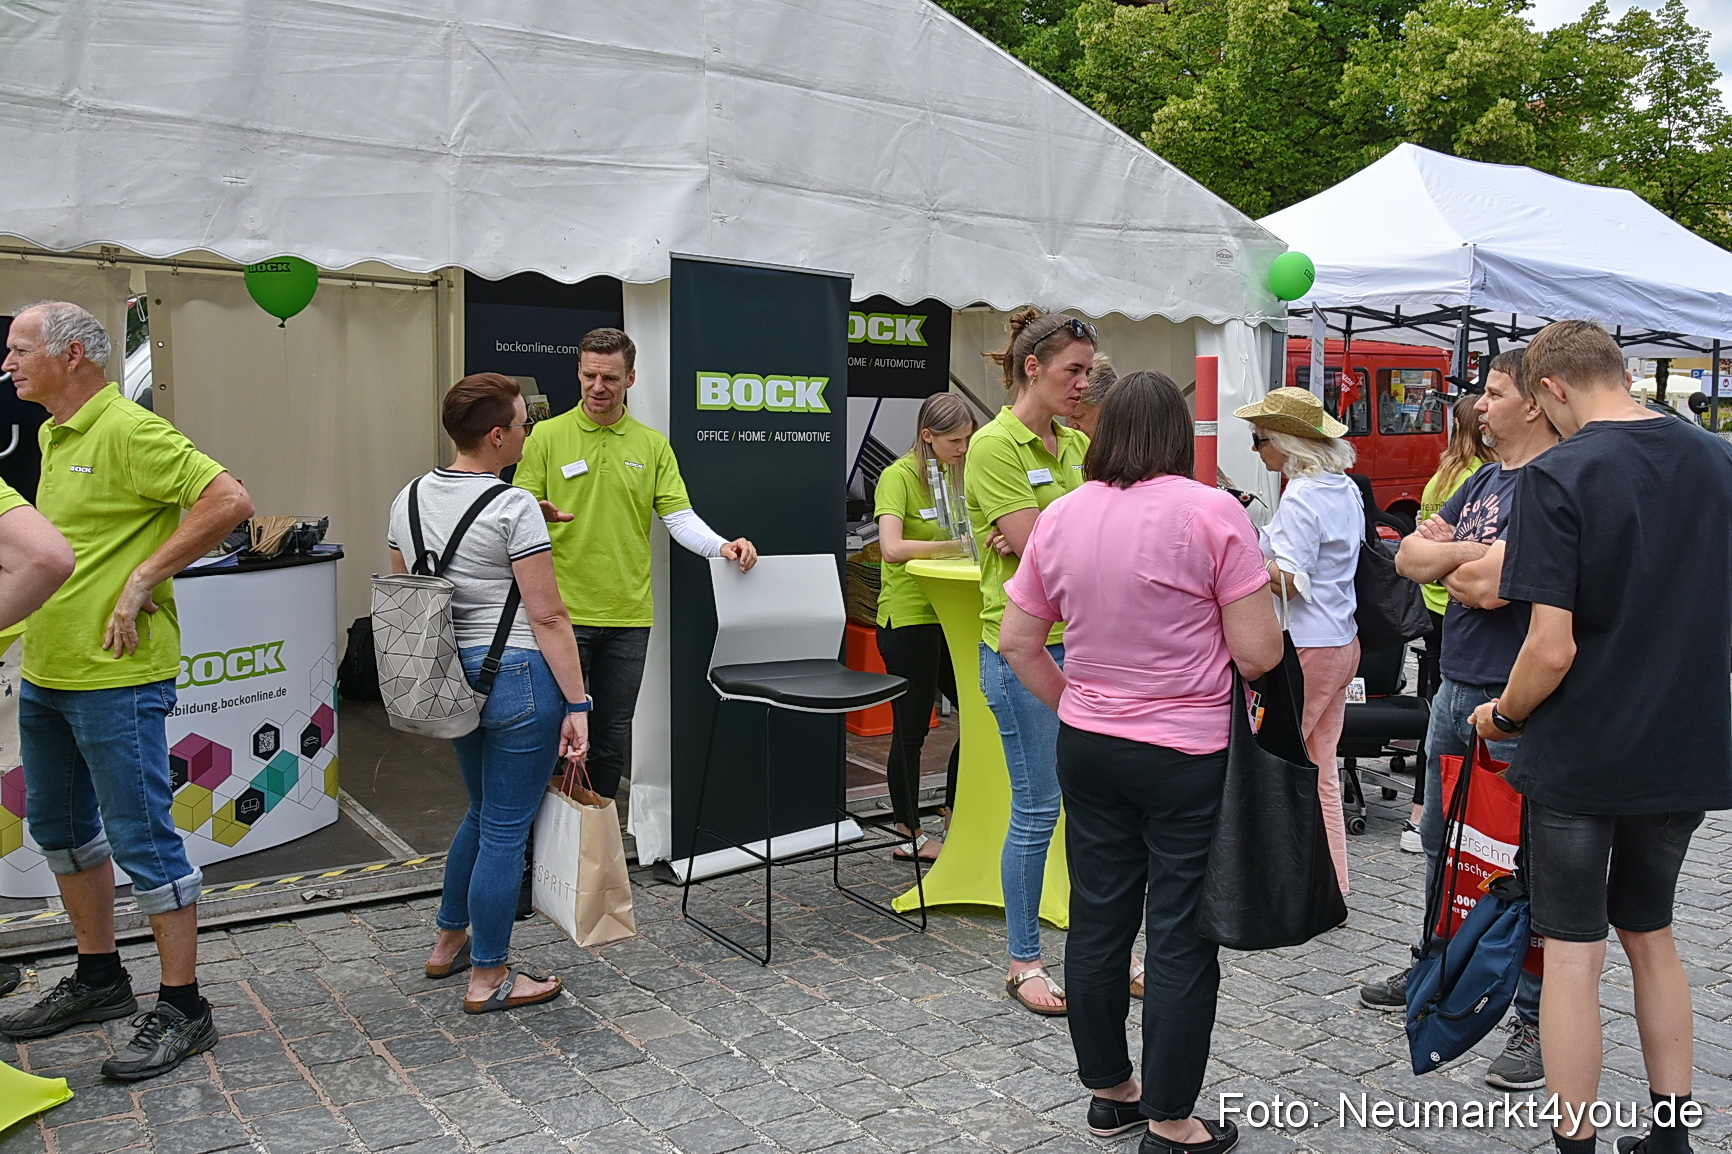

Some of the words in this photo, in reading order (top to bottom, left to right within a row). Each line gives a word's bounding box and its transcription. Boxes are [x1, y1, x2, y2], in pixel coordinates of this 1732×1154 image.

[249, 262, 291, 273] BOCK
[495, 339, 579, 355] bockonline.com
[874, 358, 927, 369] AUTOMOTIVE
[697, 372, 831, 413] BOCK
[696, 430, 729, 443] OFFICE
[737, 430, 767, 443] HOME
[774, 431, 831, 443] AUTOMOTIVE
